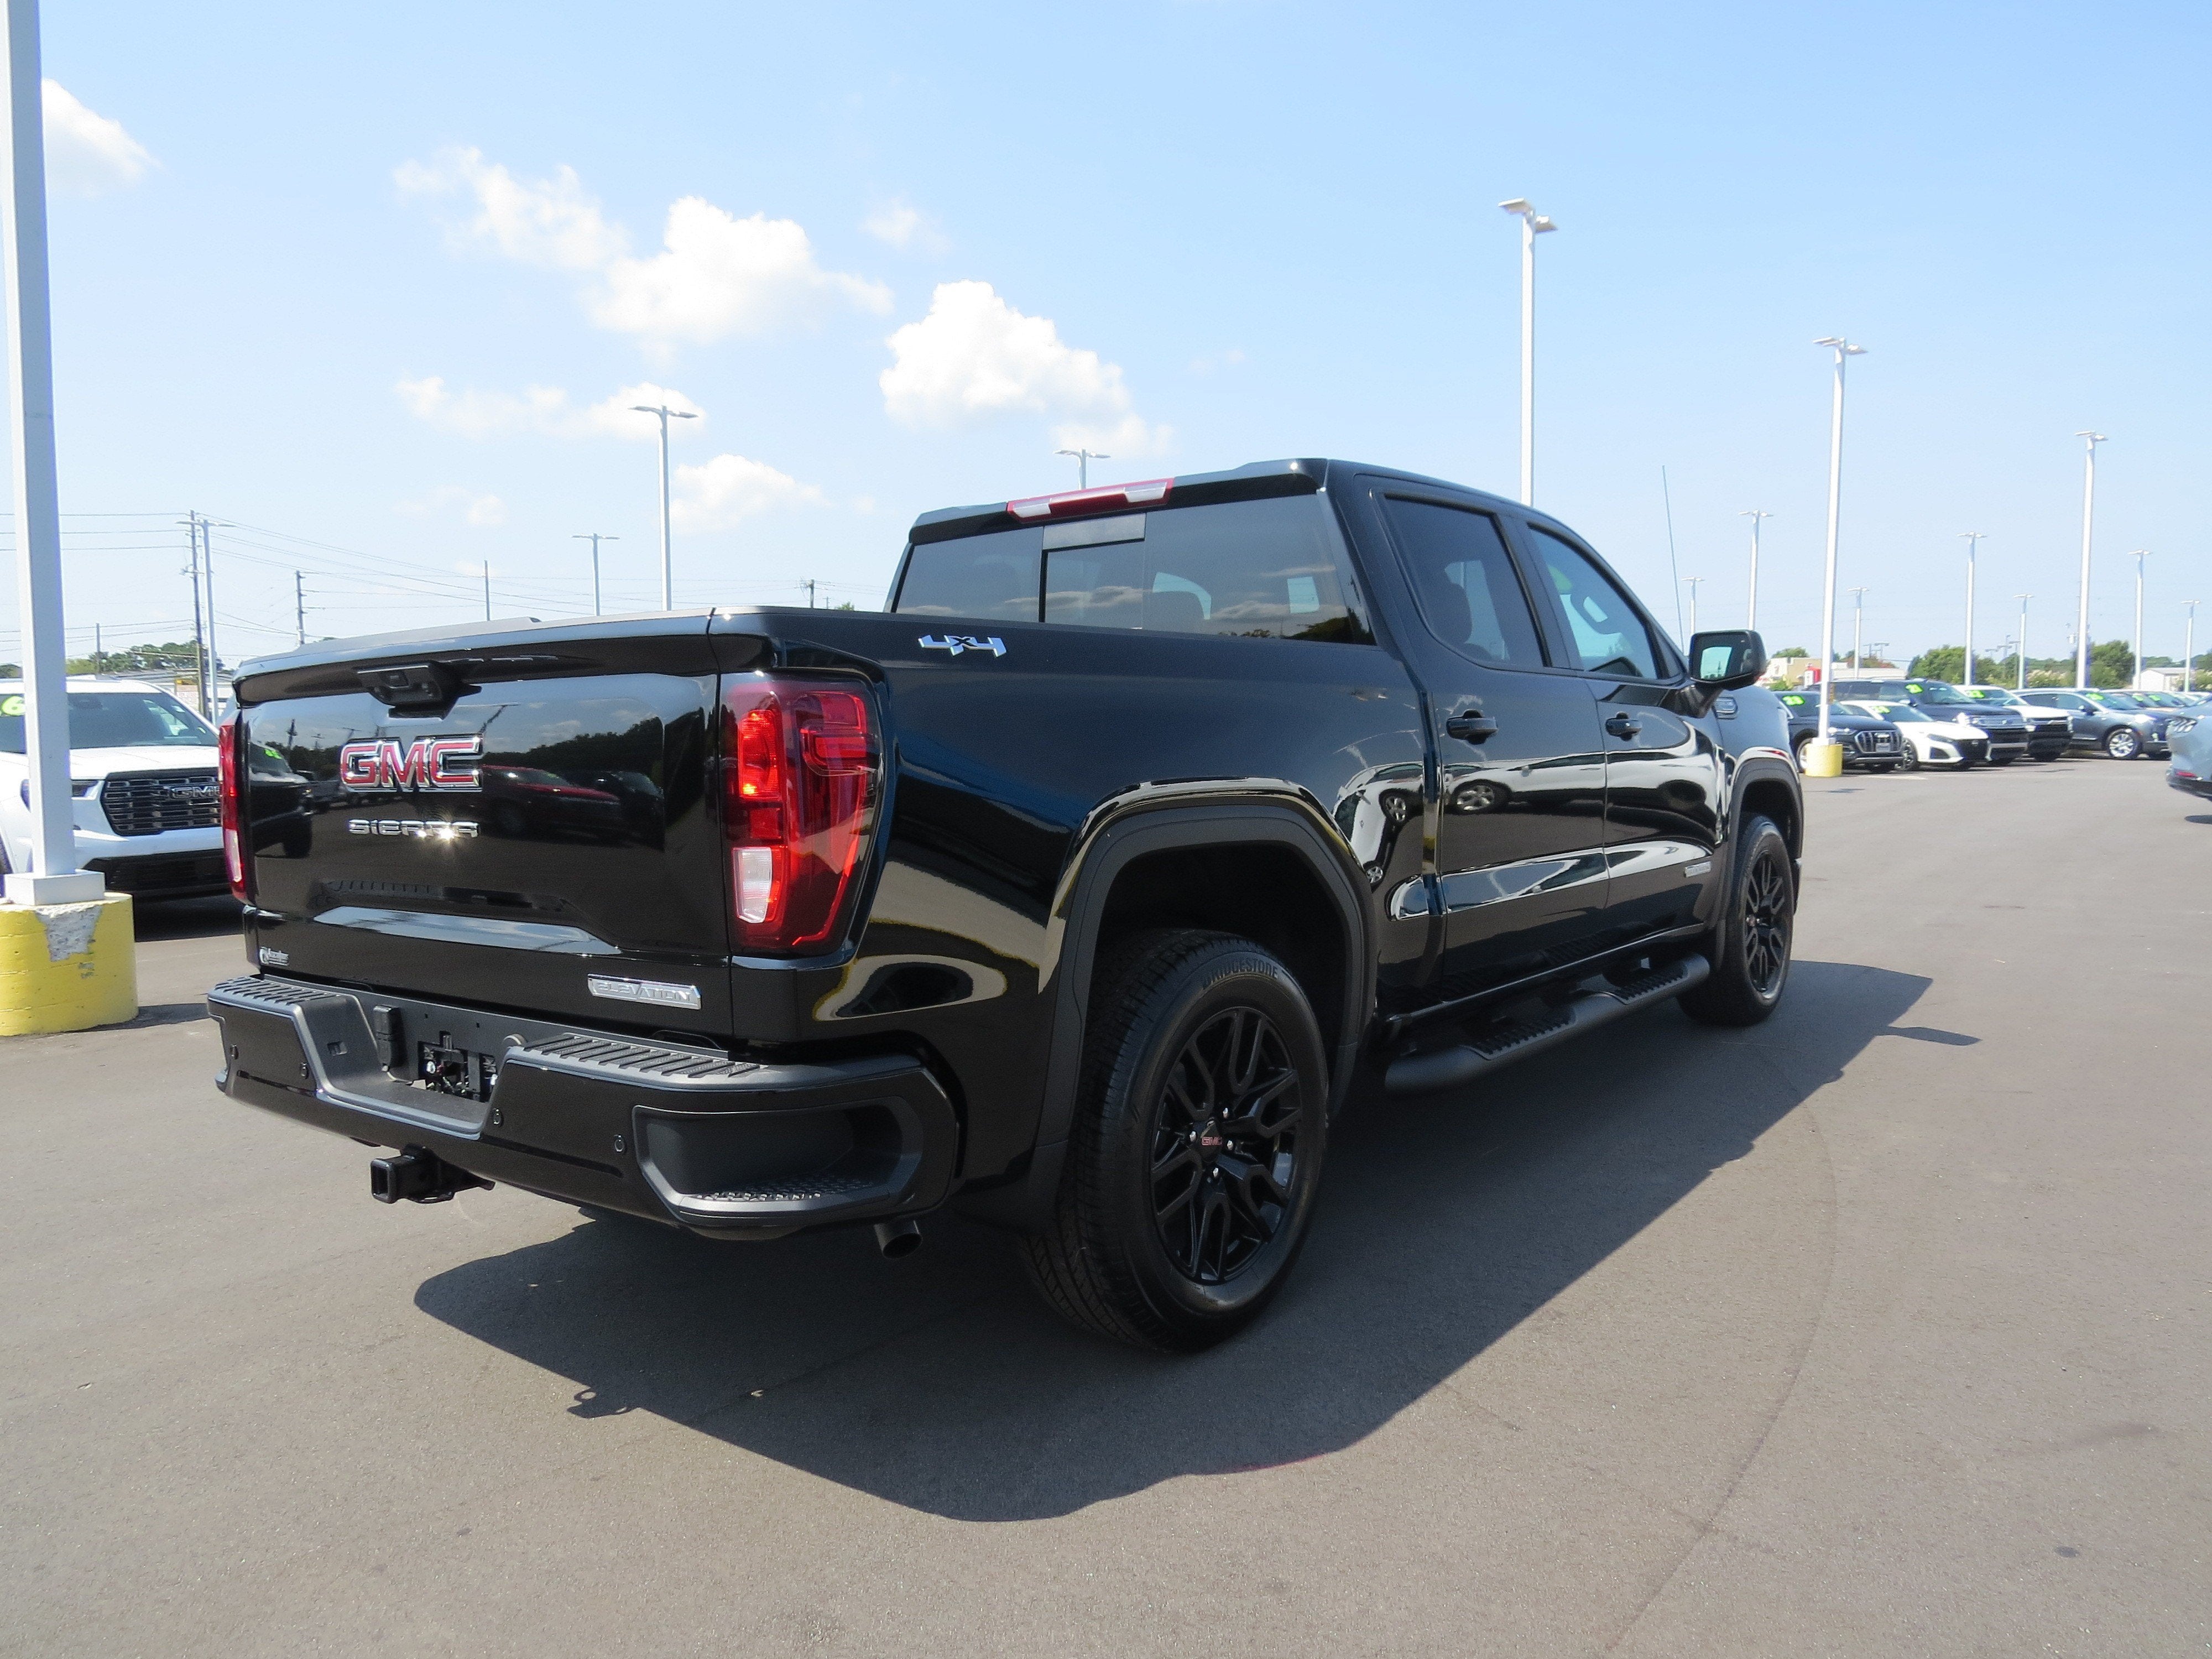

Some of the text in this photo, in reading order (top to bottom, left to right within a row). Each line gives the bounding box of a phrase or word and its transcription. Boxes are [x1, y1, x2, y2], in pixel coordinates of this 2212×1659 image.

[341, 735, 483, 792] GMC
[349, 819, 481, 838] SIERRA
[597, 981, 690, 1001] ELEVATION
